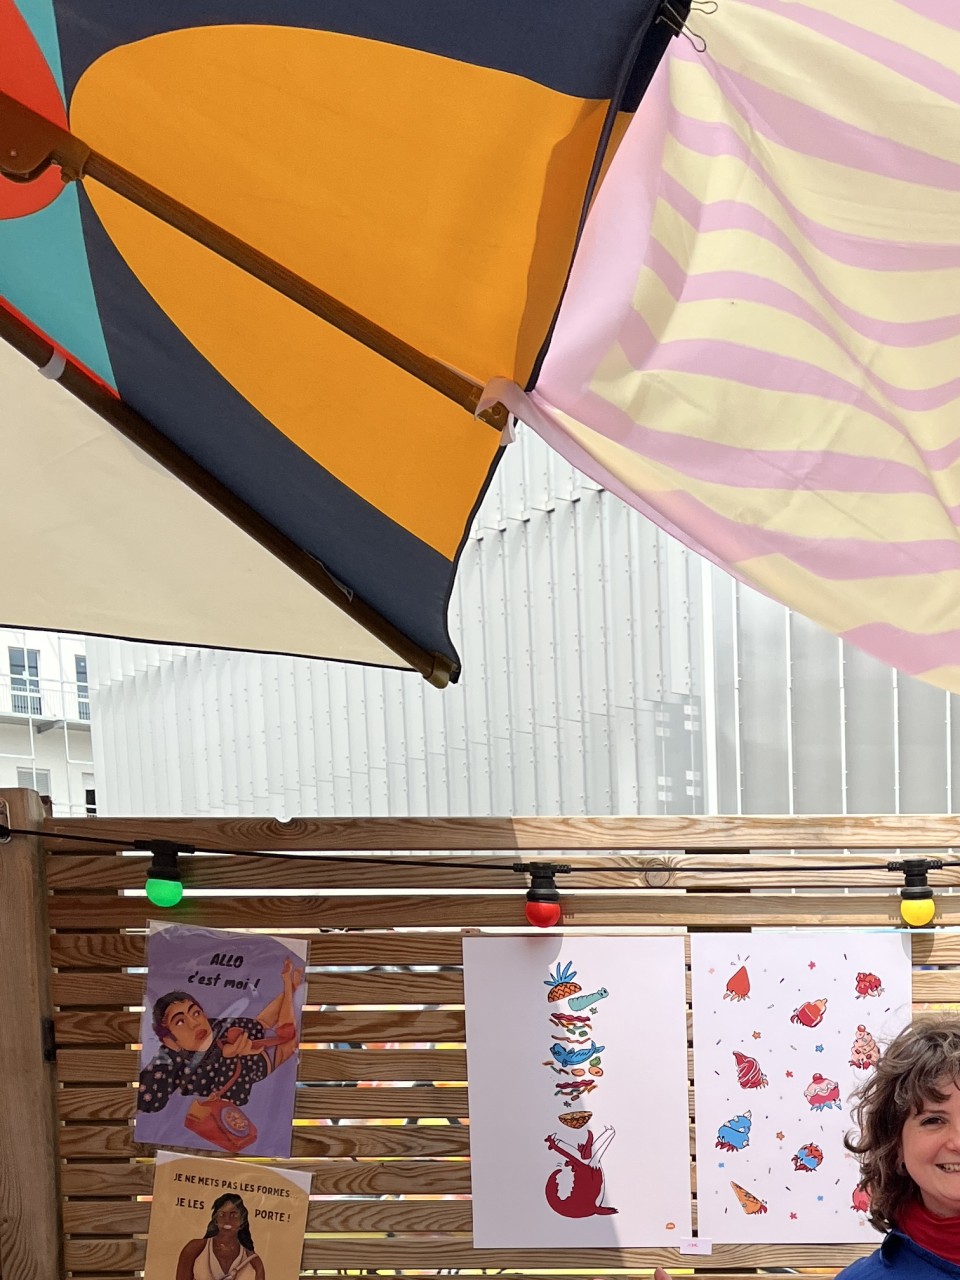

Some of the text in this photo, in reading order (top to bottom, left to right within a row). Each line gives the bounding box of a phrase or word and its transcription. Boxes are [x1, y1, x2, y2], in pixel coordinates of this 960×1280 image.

[210, 953, 243, 968] ALLO
[187, 971, 221, 986] c'est
[224, 978, 249, 990] moi
[174, 1173, 183, 1182] JE
[185, 1175, 196, 1184] NE
[198, 1176, 219, 1187] METS
[221, 1180, 237, 1190] PAS
[240, 1183, 254, 1192] LES
[175, 1197, 185, 1207] JE
[187, 1198, 204, 1210] LES
[254, 1208, 285, 1222] PORTE
